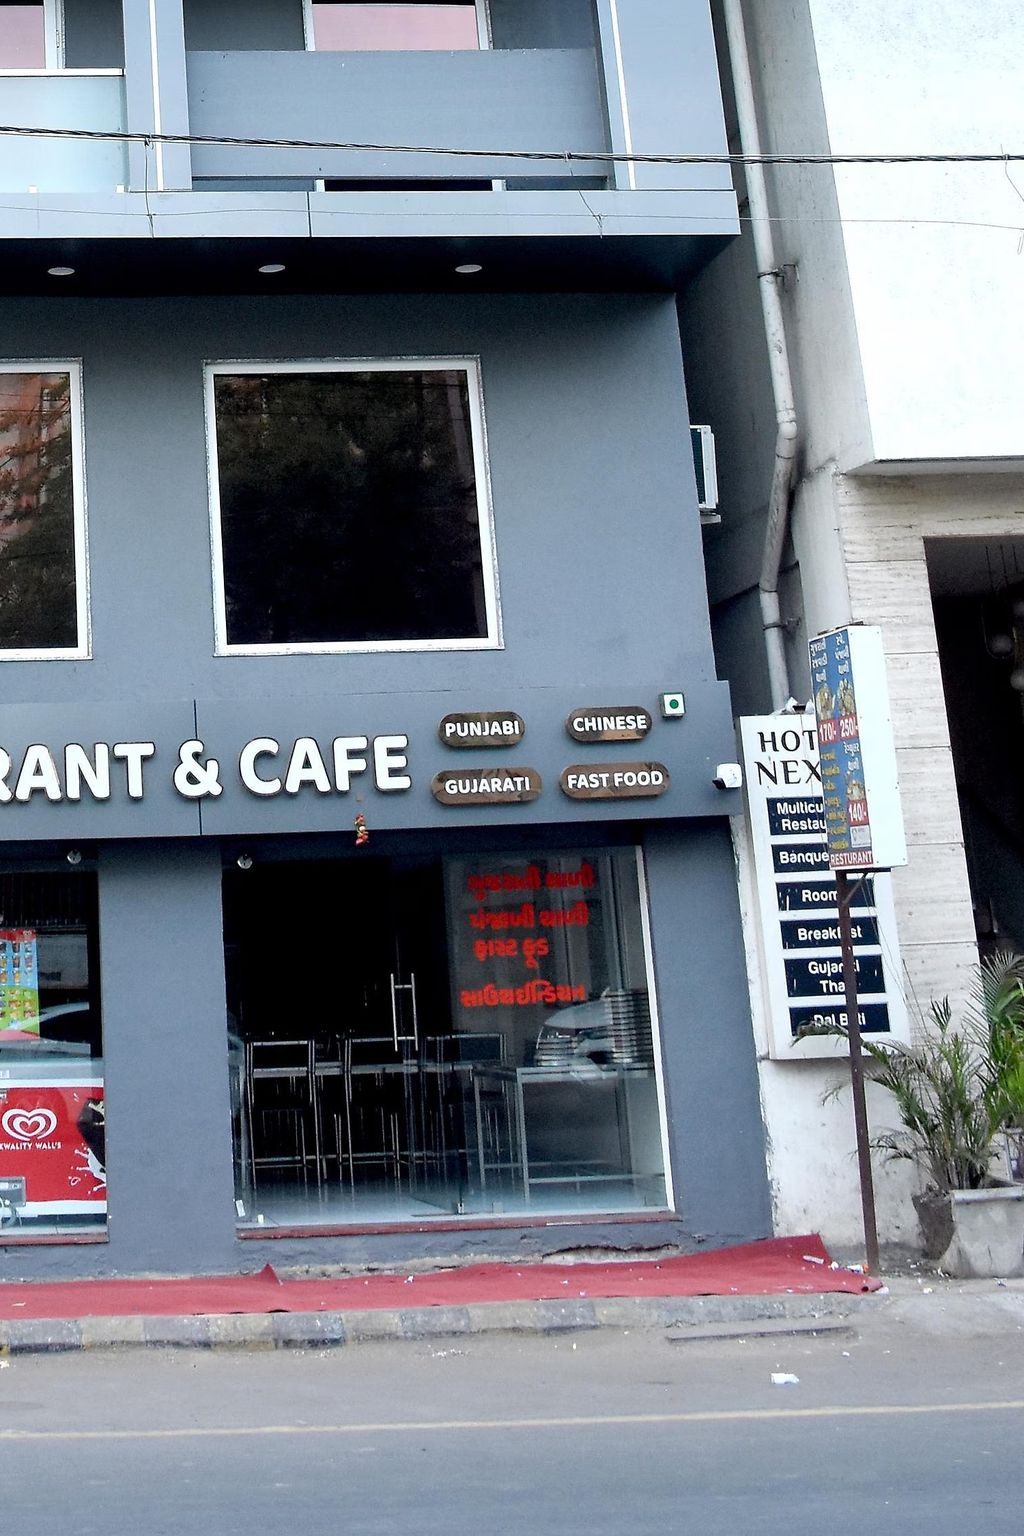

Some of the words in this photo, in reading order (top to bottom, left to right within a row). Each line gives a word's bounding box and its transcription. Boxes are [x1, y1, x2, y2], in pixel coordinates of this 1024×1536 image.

[445, 720, 520, 737] PUNJABI
[573, 715, 647, 732] CHINESE
[839, 716, 859, 738] 250/-
[173, 739, 224, 798] &
[239, 734, 413, 795] CAFE
[445, 776, 530, 794] GUJARATI
[567, 773, 610, 789] FAST
[613, 770, 663, 787] FOOD
[848, 802, 867, 822] 140/-
[830, 851, 873, 865] RESTURANT
[797, 925, 863, 941] Breakst
[808, 959, 860, 976] Gujari
[839, 1012, 866, 1026] Bti
[35, 1141, 62, 1150] WALL'S
